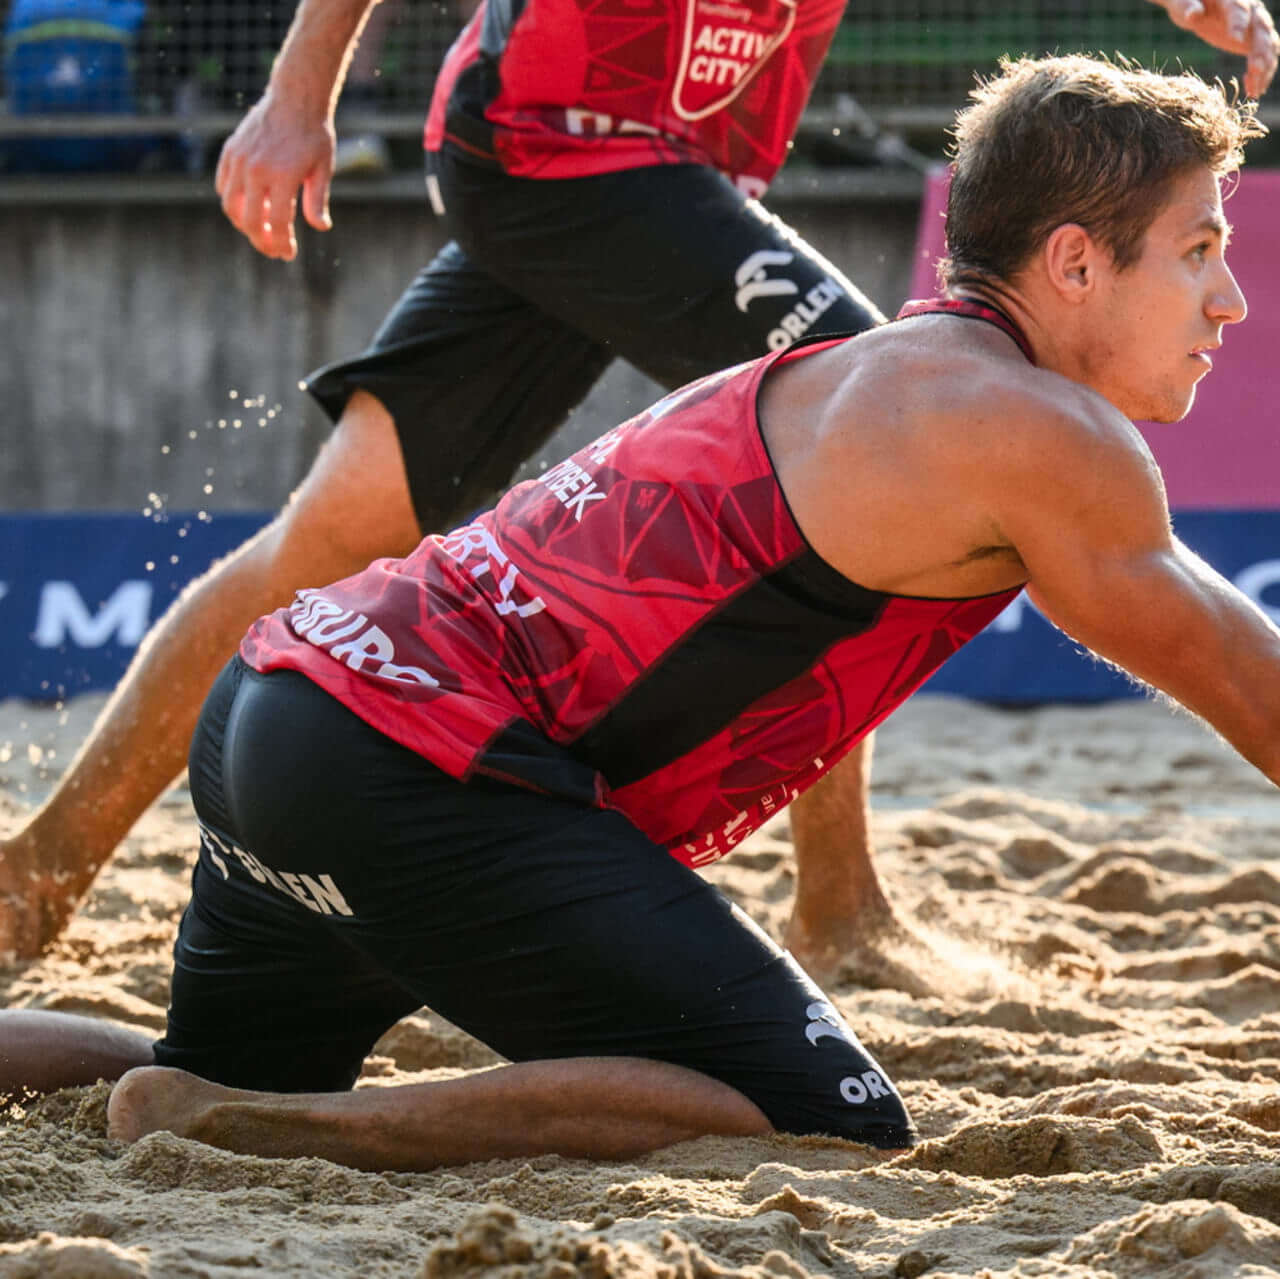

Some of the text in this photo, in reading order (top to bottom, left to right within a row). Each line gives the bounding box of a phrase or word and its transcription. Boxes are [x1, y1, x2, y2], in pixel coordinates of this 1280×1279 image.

[693, 25, 775, 59] ACTIV
[688, 54, 752, 87] CITY
[33, 580, 154, 649] M
